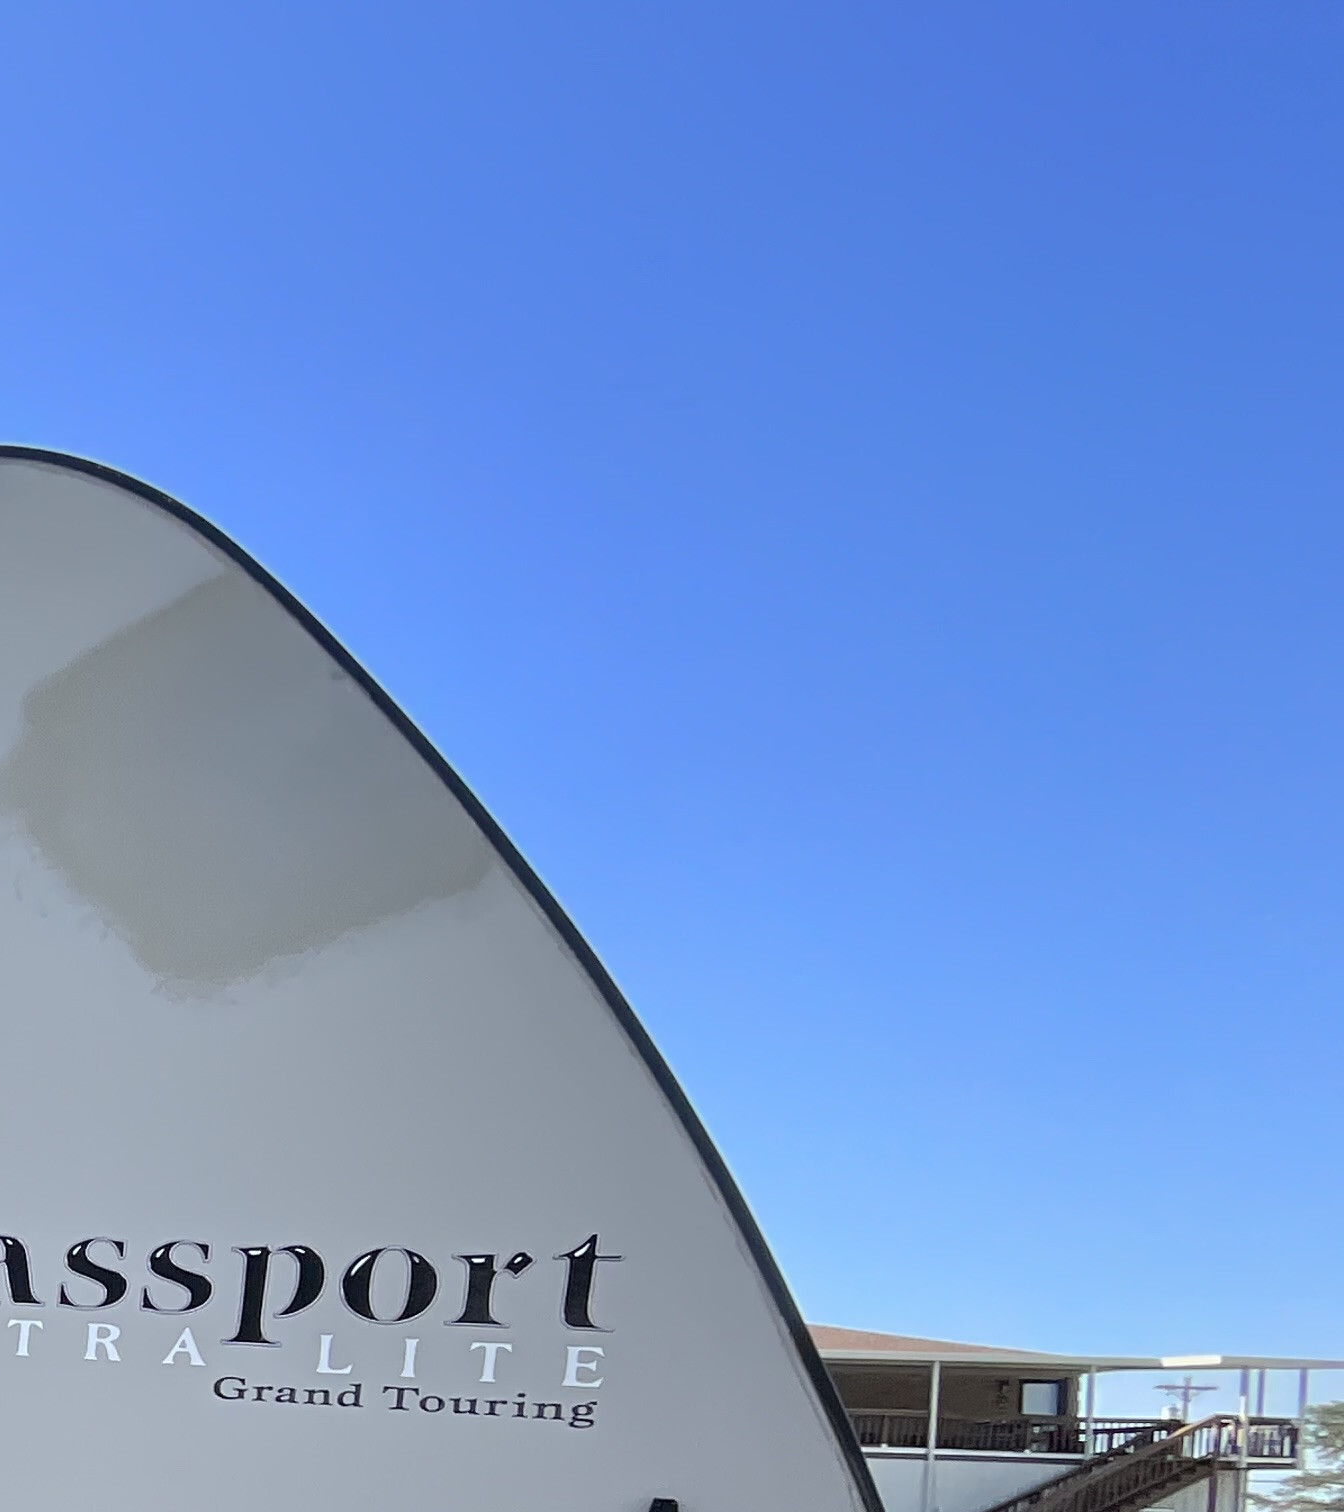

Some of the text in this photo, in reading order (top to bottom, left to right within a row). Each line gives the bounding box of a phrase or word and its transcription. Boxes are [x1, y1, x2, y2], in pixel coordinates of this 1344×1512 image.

[315, 1333, 606, 1389] LITE
[213, 1376, 599, 1430] Grand Touring
